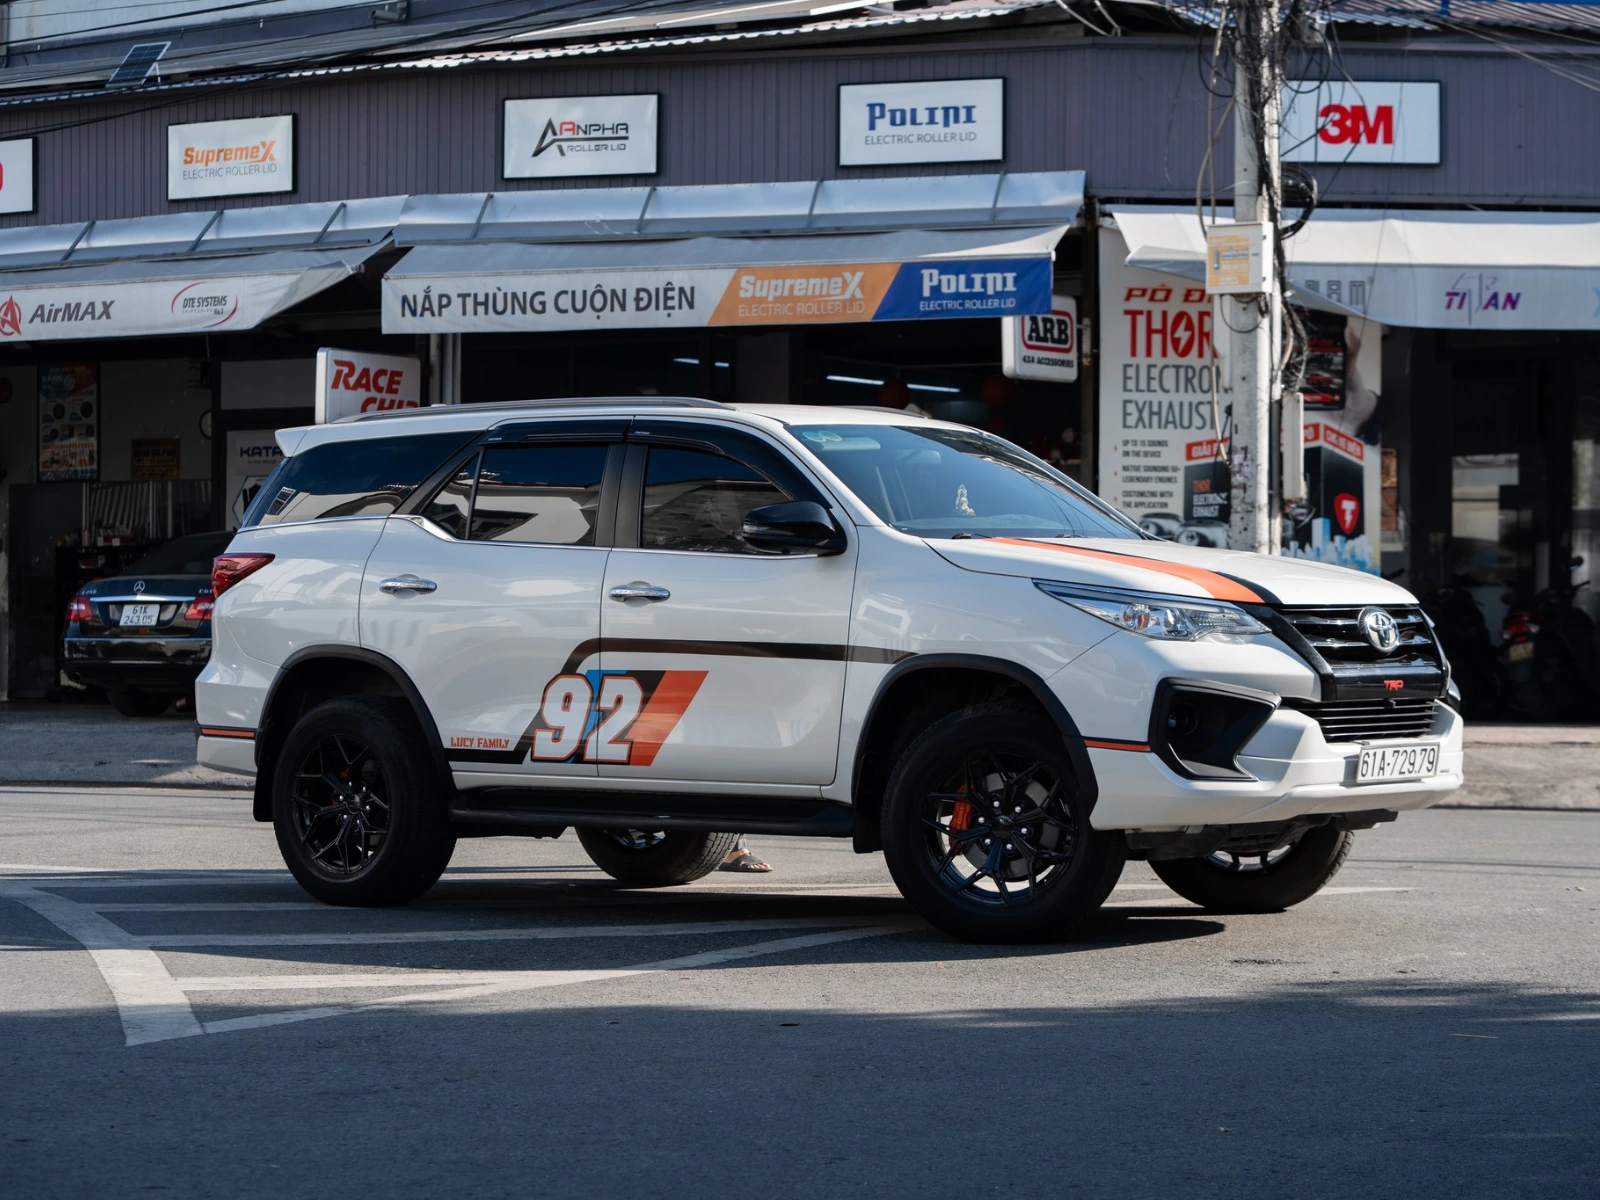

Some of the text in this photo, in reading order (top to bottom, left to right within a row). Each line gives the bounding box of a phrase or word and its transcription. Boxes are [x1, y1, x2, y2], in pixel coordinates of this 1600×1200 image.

[1318, 104, 1394, 144] 3M
[567, 143, 626, 152] ROLLER LID
[864, 131, 977, 146] ELECTRIC ROLLER LID
[183, 140, 276, 167] SupremeX
[182, 163, 277, 180] ELECTRIC ROLLER LID
[739, 271, 864, 301] SupremeX
[182, 295, 228, 309] DTE SYSTEMS
[400, 282, 695, 320] NẮP THÙNG CUỘN ĐIỆN
[738, 300, 865, 317] ELECTRIC ROLLER LID
[920, 297, 1016, 312] ELECTRIC ROLLER LID
[28, 300, 115, 324] AirMAX
[1027, 315, 1069, 346] ARB
[331, 359, 404, 395] RACE
[1122, 399, 1219, 430] EXHAUST
[132, 605, 149, 615] 61K
[1384, 680, 1404, 690] TRD
[531, 673, 644, 763] 92
[450, 737, 509, 748] LUCY FAMILY
